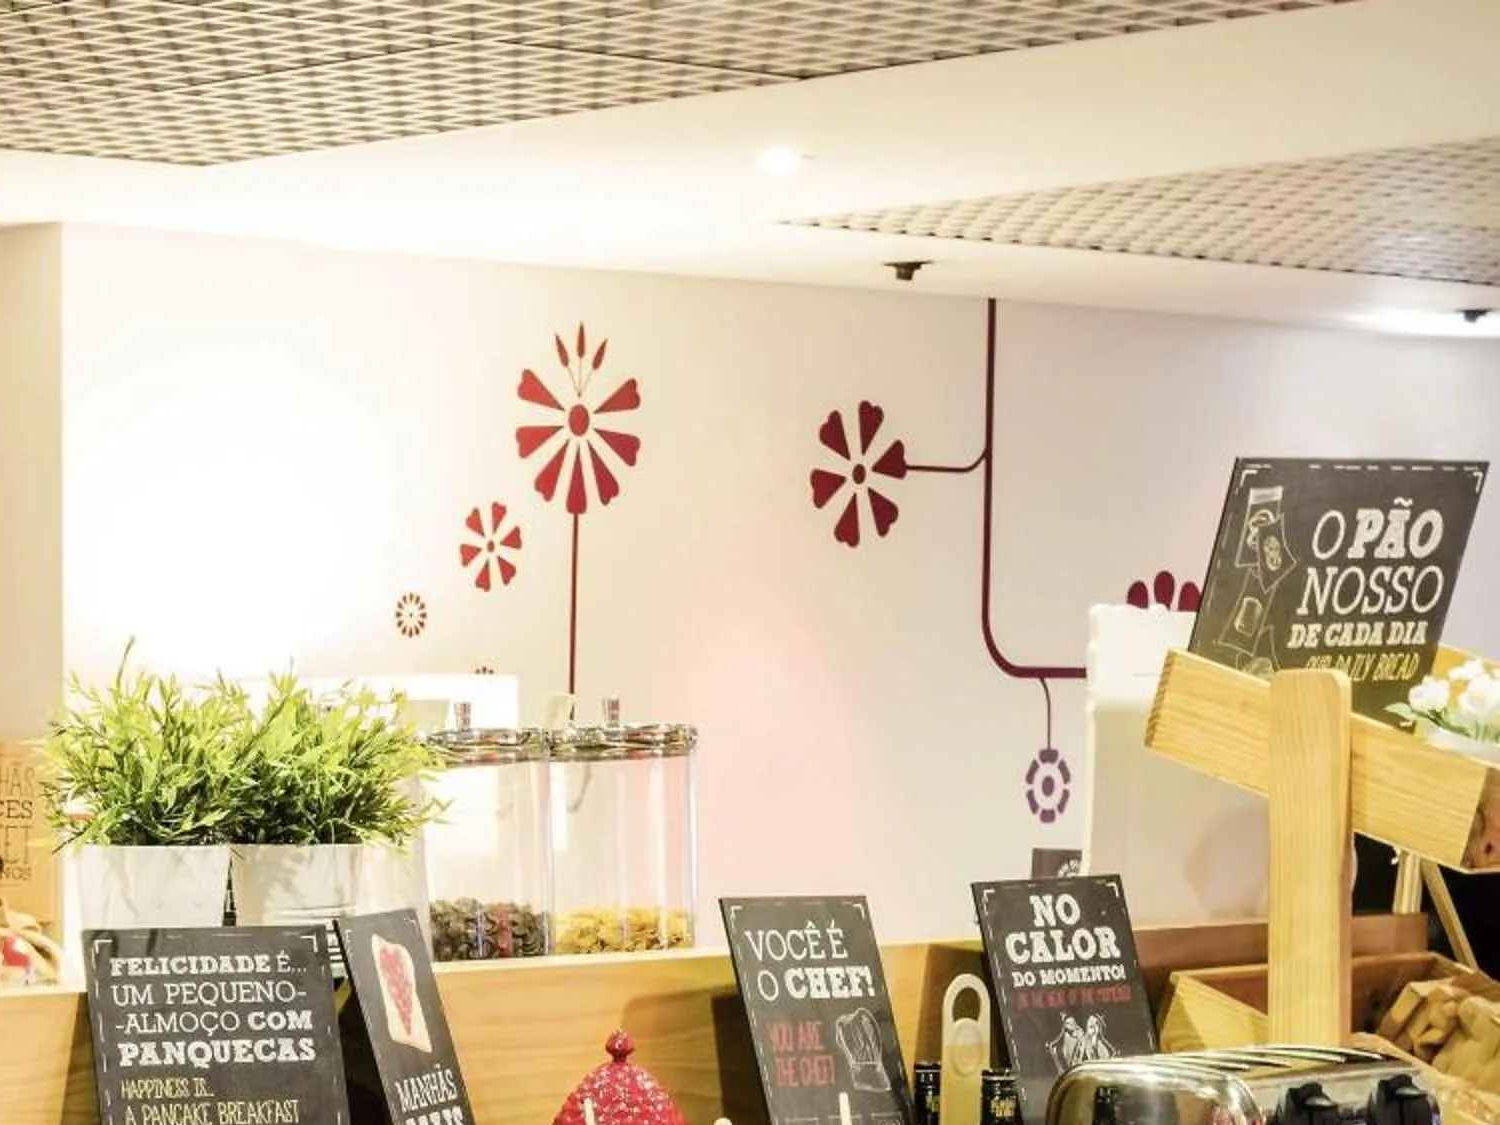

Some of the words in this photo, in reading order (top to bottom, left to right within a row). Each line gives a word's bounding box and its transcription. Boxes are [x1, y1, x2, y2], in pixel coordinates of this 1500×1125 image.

[1312, 510, 1346, 560] O
[1347, 496, 1444, 559] PÃO
[1296, 565, 1445, 616] NOSSO
[1287, 623, 1322, 648] DE
[1323, 623, 1383, 646] CADA
[1386, 621, 1428, 645] DIA
[1029, 893, 1081, 928] NO
[743, 920, 827, 961] VOCÊ
[825, 919, 849, 960] É
[1005, 926, 1121, 965] CALOR
[110, 953, 271, 977] FELICIDADE
[1011, 971, 1037, 988] DO
[110, 984, 154, 1007] UM
[164, 980, 307, 1007] PEQUENO-
[757, 970, 779, 1001] O
[783, 965, 876, 999] CHEF!
[116, 1011, 241, 1037] -ALMOÇO
[247, 1009, 313, 1031] COM
[117, 1037, 316, 1069] PANQUECAS
[121, 1078, 190, 1100] HAPPINESS
[395, 1063, 458, 1113] MANHÃS
[217, 1099, 300, 1125] BREAKFAST
